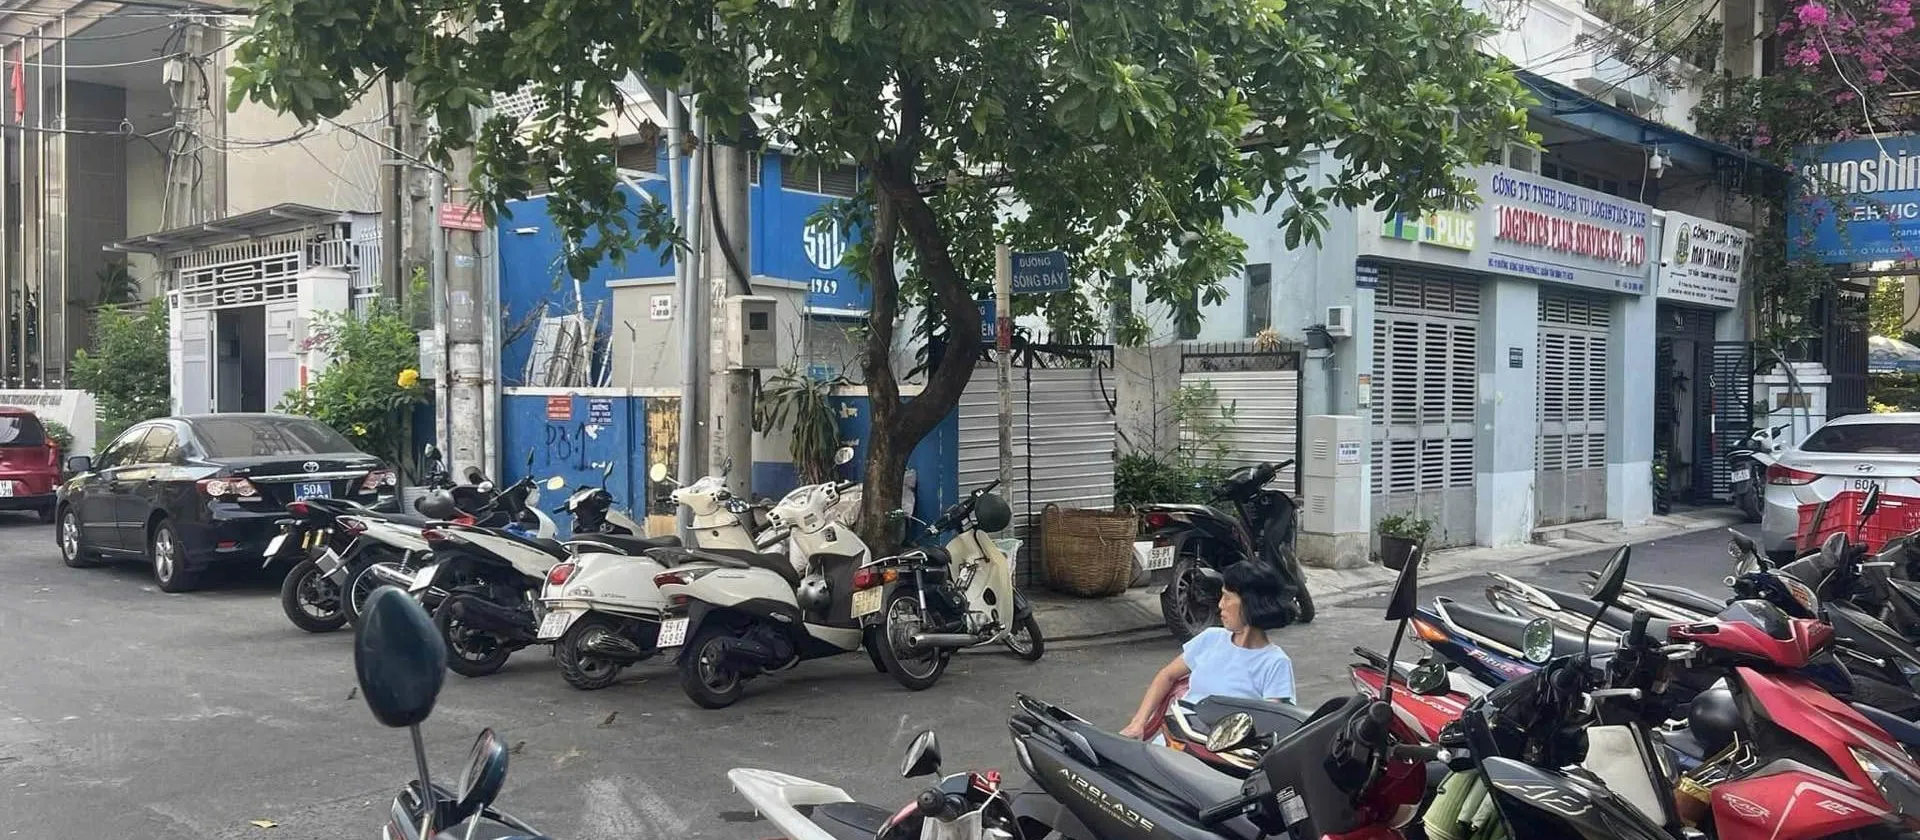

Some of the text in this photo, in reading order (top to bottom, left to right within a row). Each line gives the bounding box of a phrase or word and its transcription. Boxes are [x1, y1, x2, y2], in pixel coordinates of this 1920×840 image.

[1492, 172, 1517, 197] CÔNG
[1518, 182, 1531, 200] TY
[1531, 184, 1556, 207] TNHH
[1590, 198, 1629, 224] LOGISTICS
[1629, 208, 1646, 228] PLUS
[1438, 214, 1476, 247] PLUS
[1497, 204, 1550, 246] LOGISTICS
[1550, 216, 1574, 252] PLUS
[1575, 222, 1611, 260] SERVICE
[1691, 245, 1705, 264] MAI
[1705, 248, 1726, 270] THANH
[811, 278, 838, 294] 1969
[1013, 271, 1041, 288] SÔNG
[303, 484, 323, 495] 50A
[1059, 768, 1154, 832] AIRBLADE
[1815, 800, 1856, 815] 125
